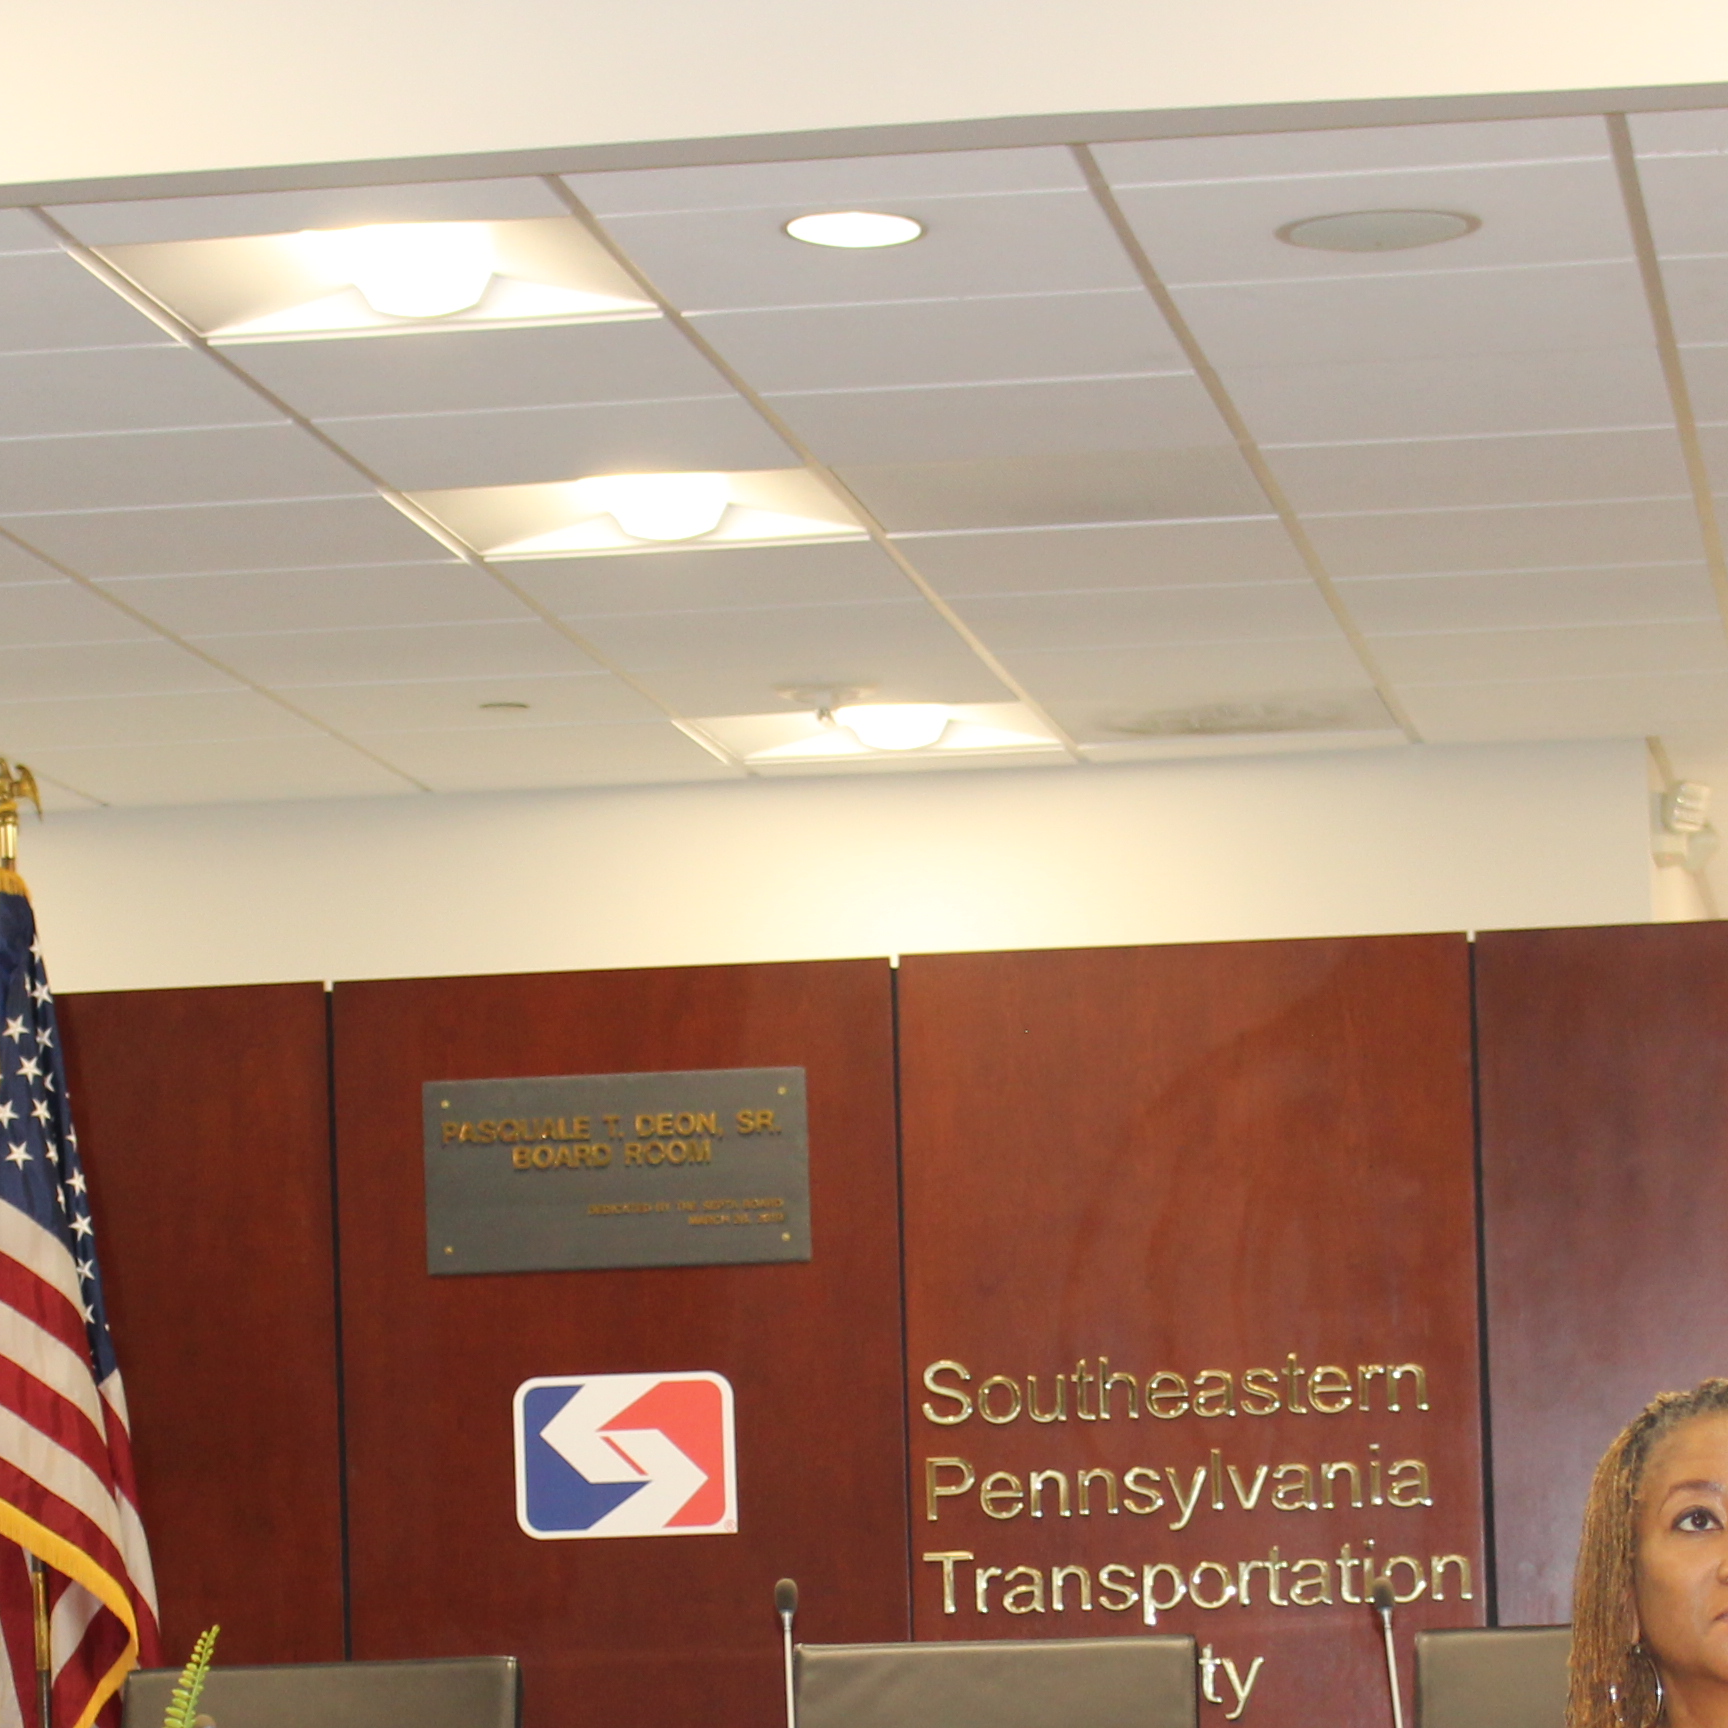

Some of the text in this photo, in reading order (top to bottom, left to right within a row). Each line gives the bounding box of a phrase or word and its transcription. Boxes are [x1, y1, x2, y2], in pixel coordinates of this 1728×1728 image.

[441, 1108, 783, 1144] PASQUALE T. DEON, SR.
[512, 1139, 713, 1170] BOARD ROOM
[921, 1352, 1430, 1426] Southeastern
[924, 1443, 1434, 1531] Pennsylvania
[922, 1538, 1472, 1626] Transportation
[1199, 1643, 1265, 1721] ty
